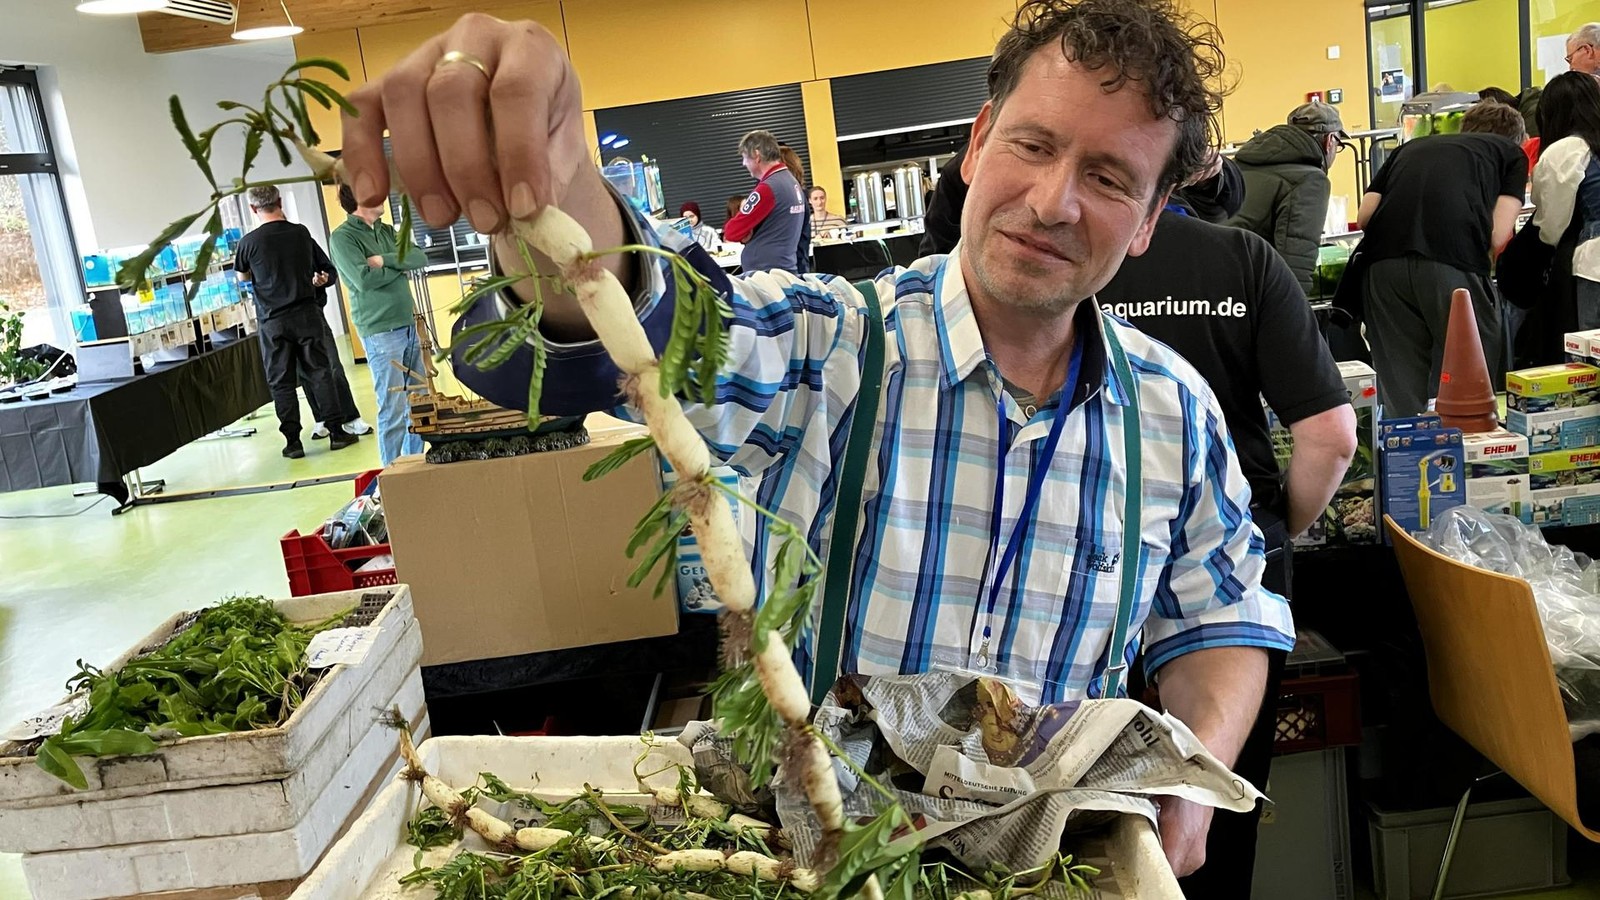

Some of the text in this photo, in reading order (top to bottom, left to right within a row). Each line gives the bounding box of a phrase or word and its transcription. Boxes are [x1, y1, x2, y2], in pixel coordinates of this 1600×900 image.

[1101, 296, 1247, 321] aquarium.de
[1567, 373, 1597, 385] EHEIM
[1484, 444, 1517, 455] EHEIM
[944, 771, 1028, 796] MITTELDEUTSCHE ZEITUNG
